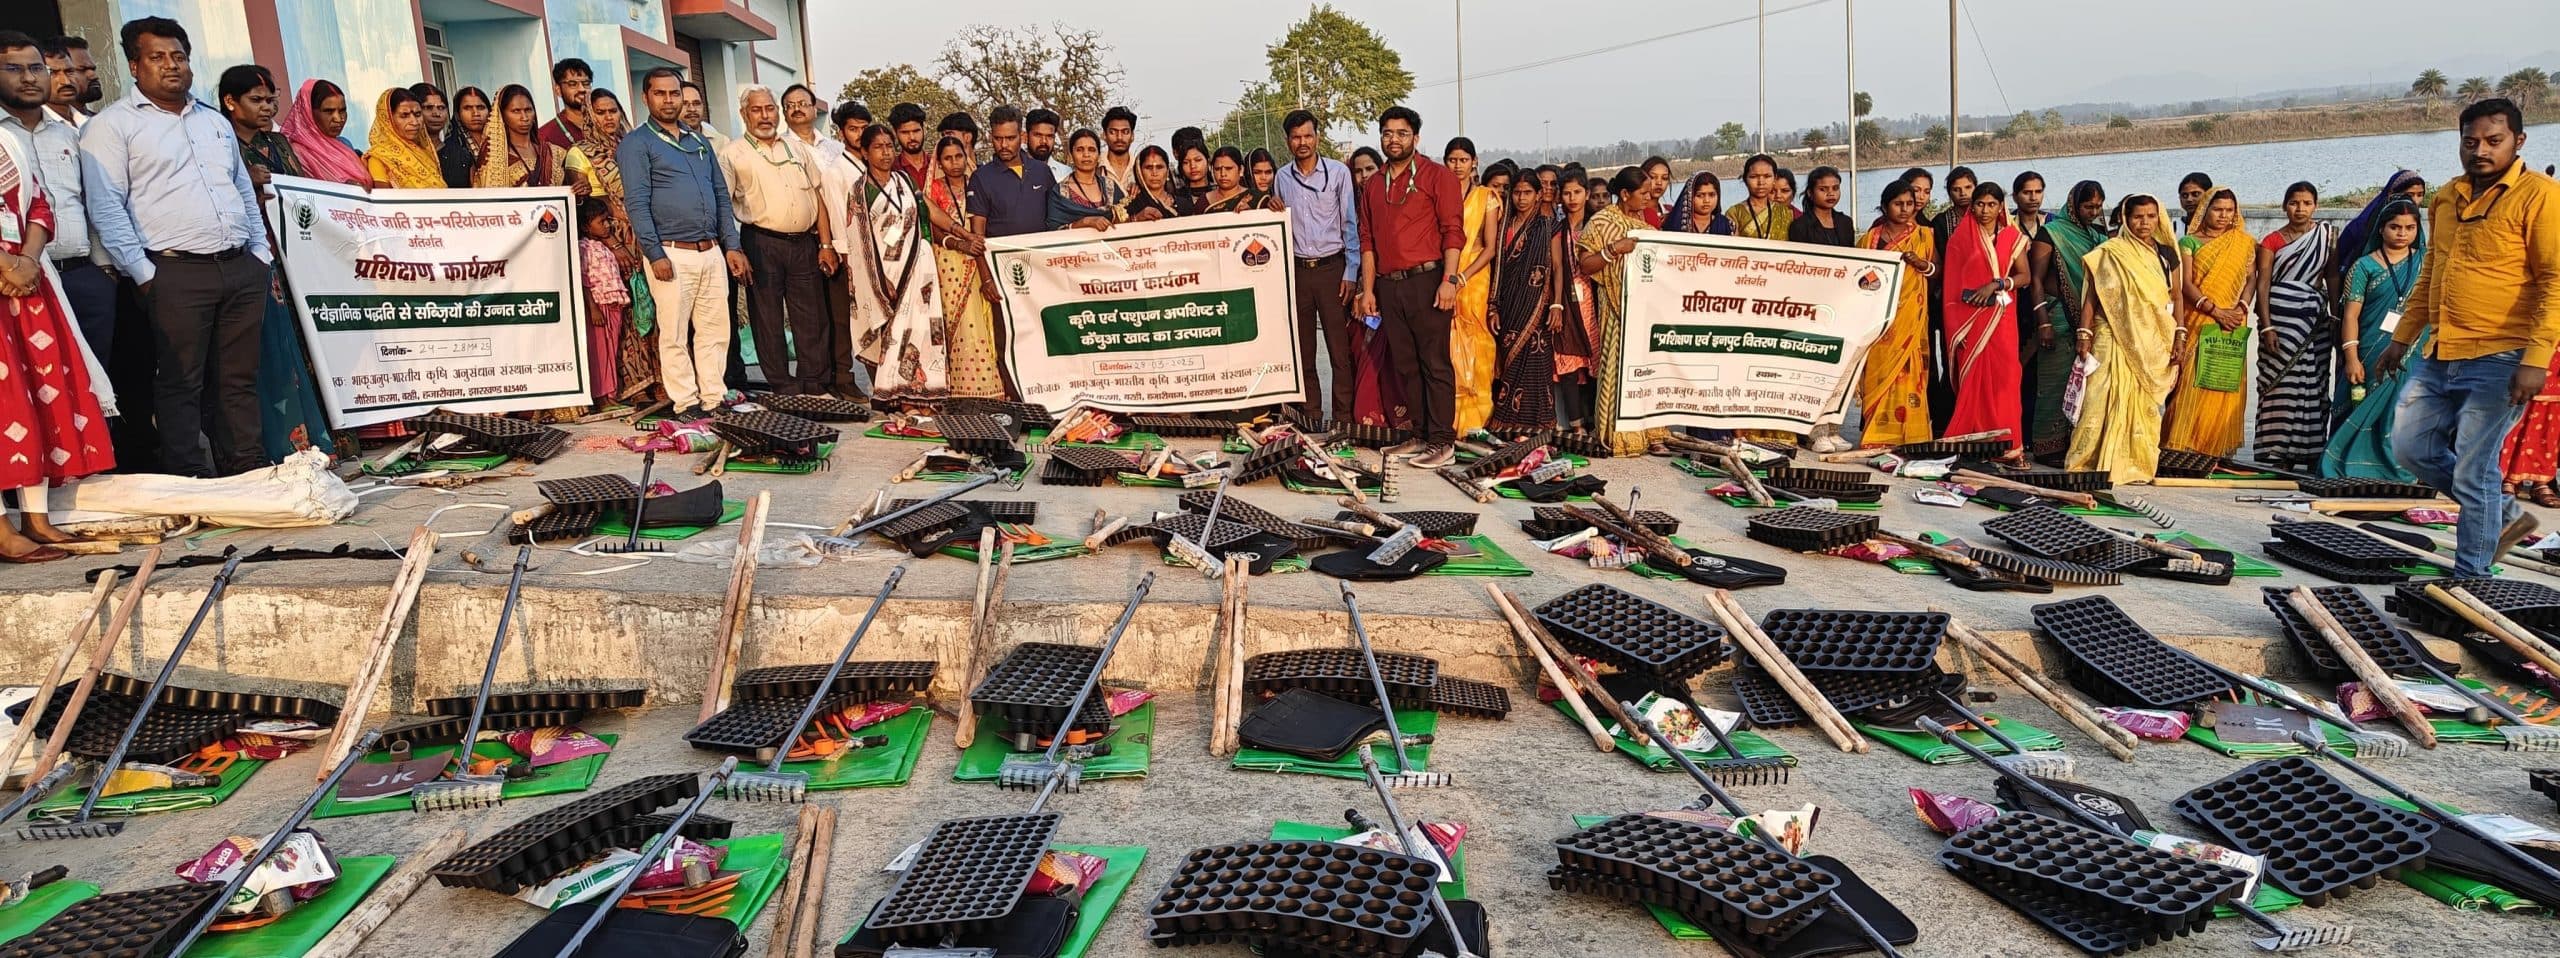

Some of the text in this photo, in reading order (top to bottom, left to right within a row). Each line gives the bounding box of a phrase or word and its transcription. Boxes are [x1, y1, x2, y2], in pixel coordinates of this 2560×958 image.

[328, 208, 379, 231] अनुसूचित
[379, 212, 411, 229] जाति
[507, 210, 522, 226] के
[408, 234, 443, 248] अंतर्गत
[1046, 251, 1100, 269] अनुसूचित
[1217, 237, 1231, 250] के
[354, 254, 508, 282] प्रशिक्षण कार्यक्रम
[1666, 252, 1717, 272] अनुसूचित
[1720, 256, 1750, 271] जाति
[1834, 265, 1848, 279] के
[1079, 271, 1200, 295] प्रशिक्षण कार्यक्रम
[1735, 274, 1768, 287] अंतर्गत
[363, 301, 396, 322] पद्धति
[399, 302, 411, 320] से
[465, 301, 481, 318] की
[484, 304, 515, 317] उन्नत
[1068, 300, 1229, 329] कृषि एवं पशुधन अपशिष्ट से
[1682, 290, 1820, 320] प्रशिक्षण कार्यक्रम
[1122, 332, 1150, 344] खाद
[1152, 330, 1172, 343] का
[1174, 326, 1222, 340] उत्पादन
[1694, 332, 1712, 346] एवं
[1712, 335, 1741, 351] इनपुट
[1743, 331, 1776, 349] वितरण
[364, 769, 417, 787] JK
